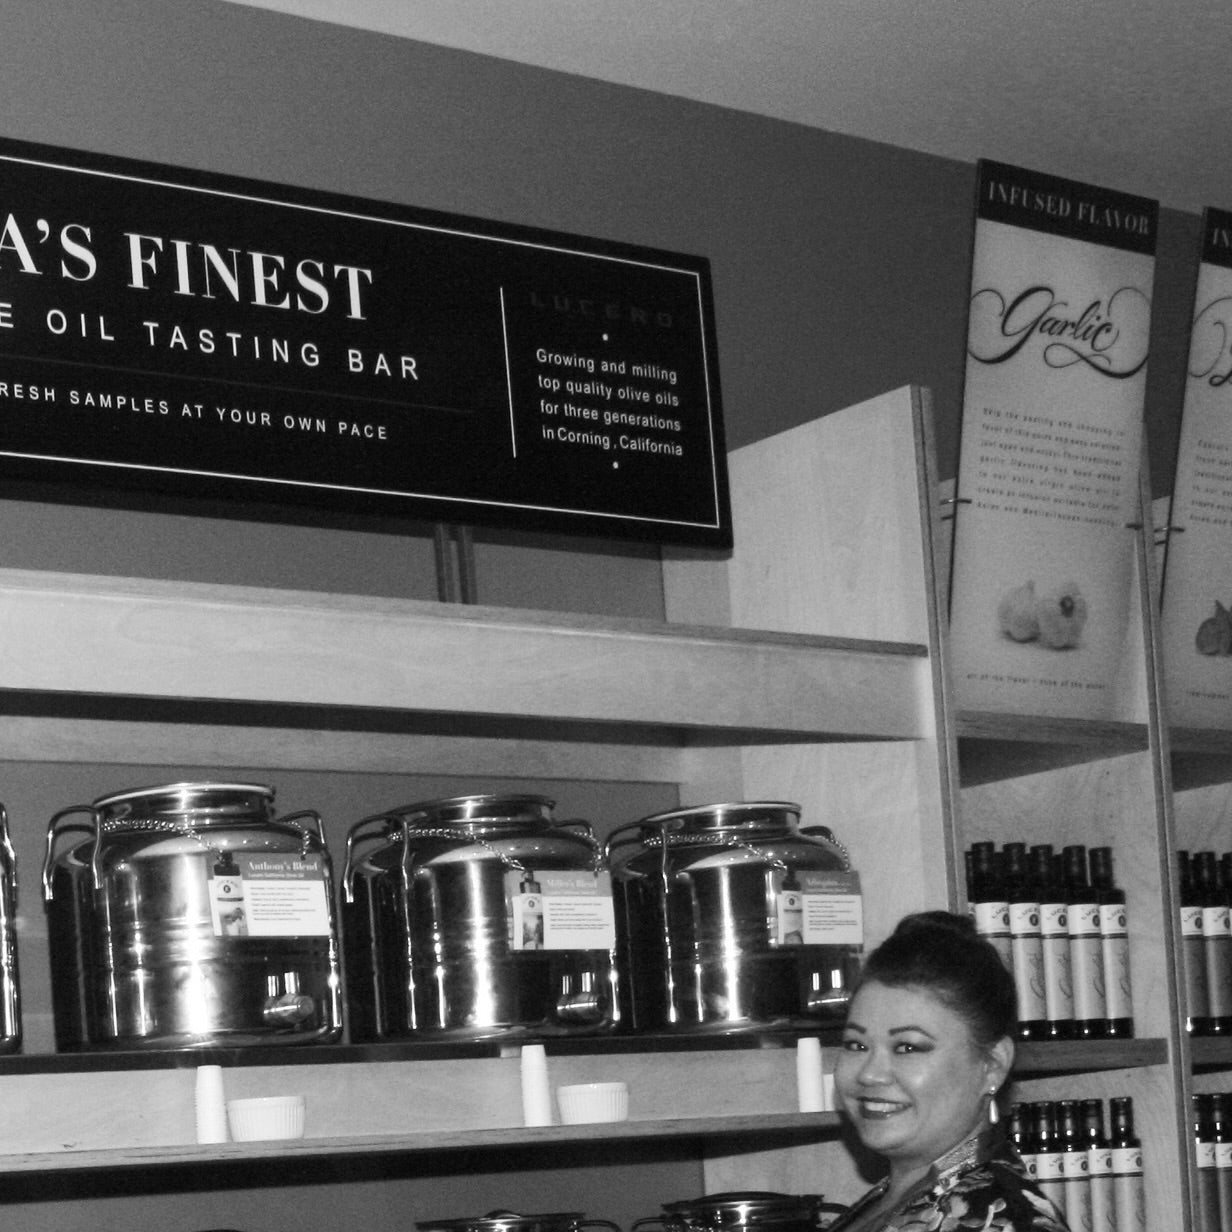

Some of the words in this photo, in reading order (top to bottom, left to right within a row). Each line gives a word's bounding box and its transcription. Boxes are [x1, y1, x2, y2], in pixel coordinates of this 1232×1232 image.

[988, 182, 1071, 217] INFUSED
[1077, 201, 1150, 235] FLAVOR
[124, 232, 373, 320] FINEST
[46, 308, 116, 342] OIL
[143, 321, 321, 367] TASTING
[348, 349, 419, 380] BAR
[536, 348, 595, 373] Growing
[601, 360, 626, 374] and
[632, 364, 677, 385] milling
[538, 374, 560, 392] top
[566, 380, 612, 400] quality
[618, 386, 650, 402] olive
[655, 392, 679, 407] oils
[70, 390, 169, 415] SAMPLES
[181, 403, 204, 419] AT
[216, 407, 271, 427] YOUR
[283, 415, 327, 433] OWN
[338, 422, 388, 440] PACE
[540, 399, 559, 414] for
[564, 403, 598, 421] three
[603, 410, 682, 432] generations
[542, 425, 554, 440] in
[619, 435, 683, 456] California
